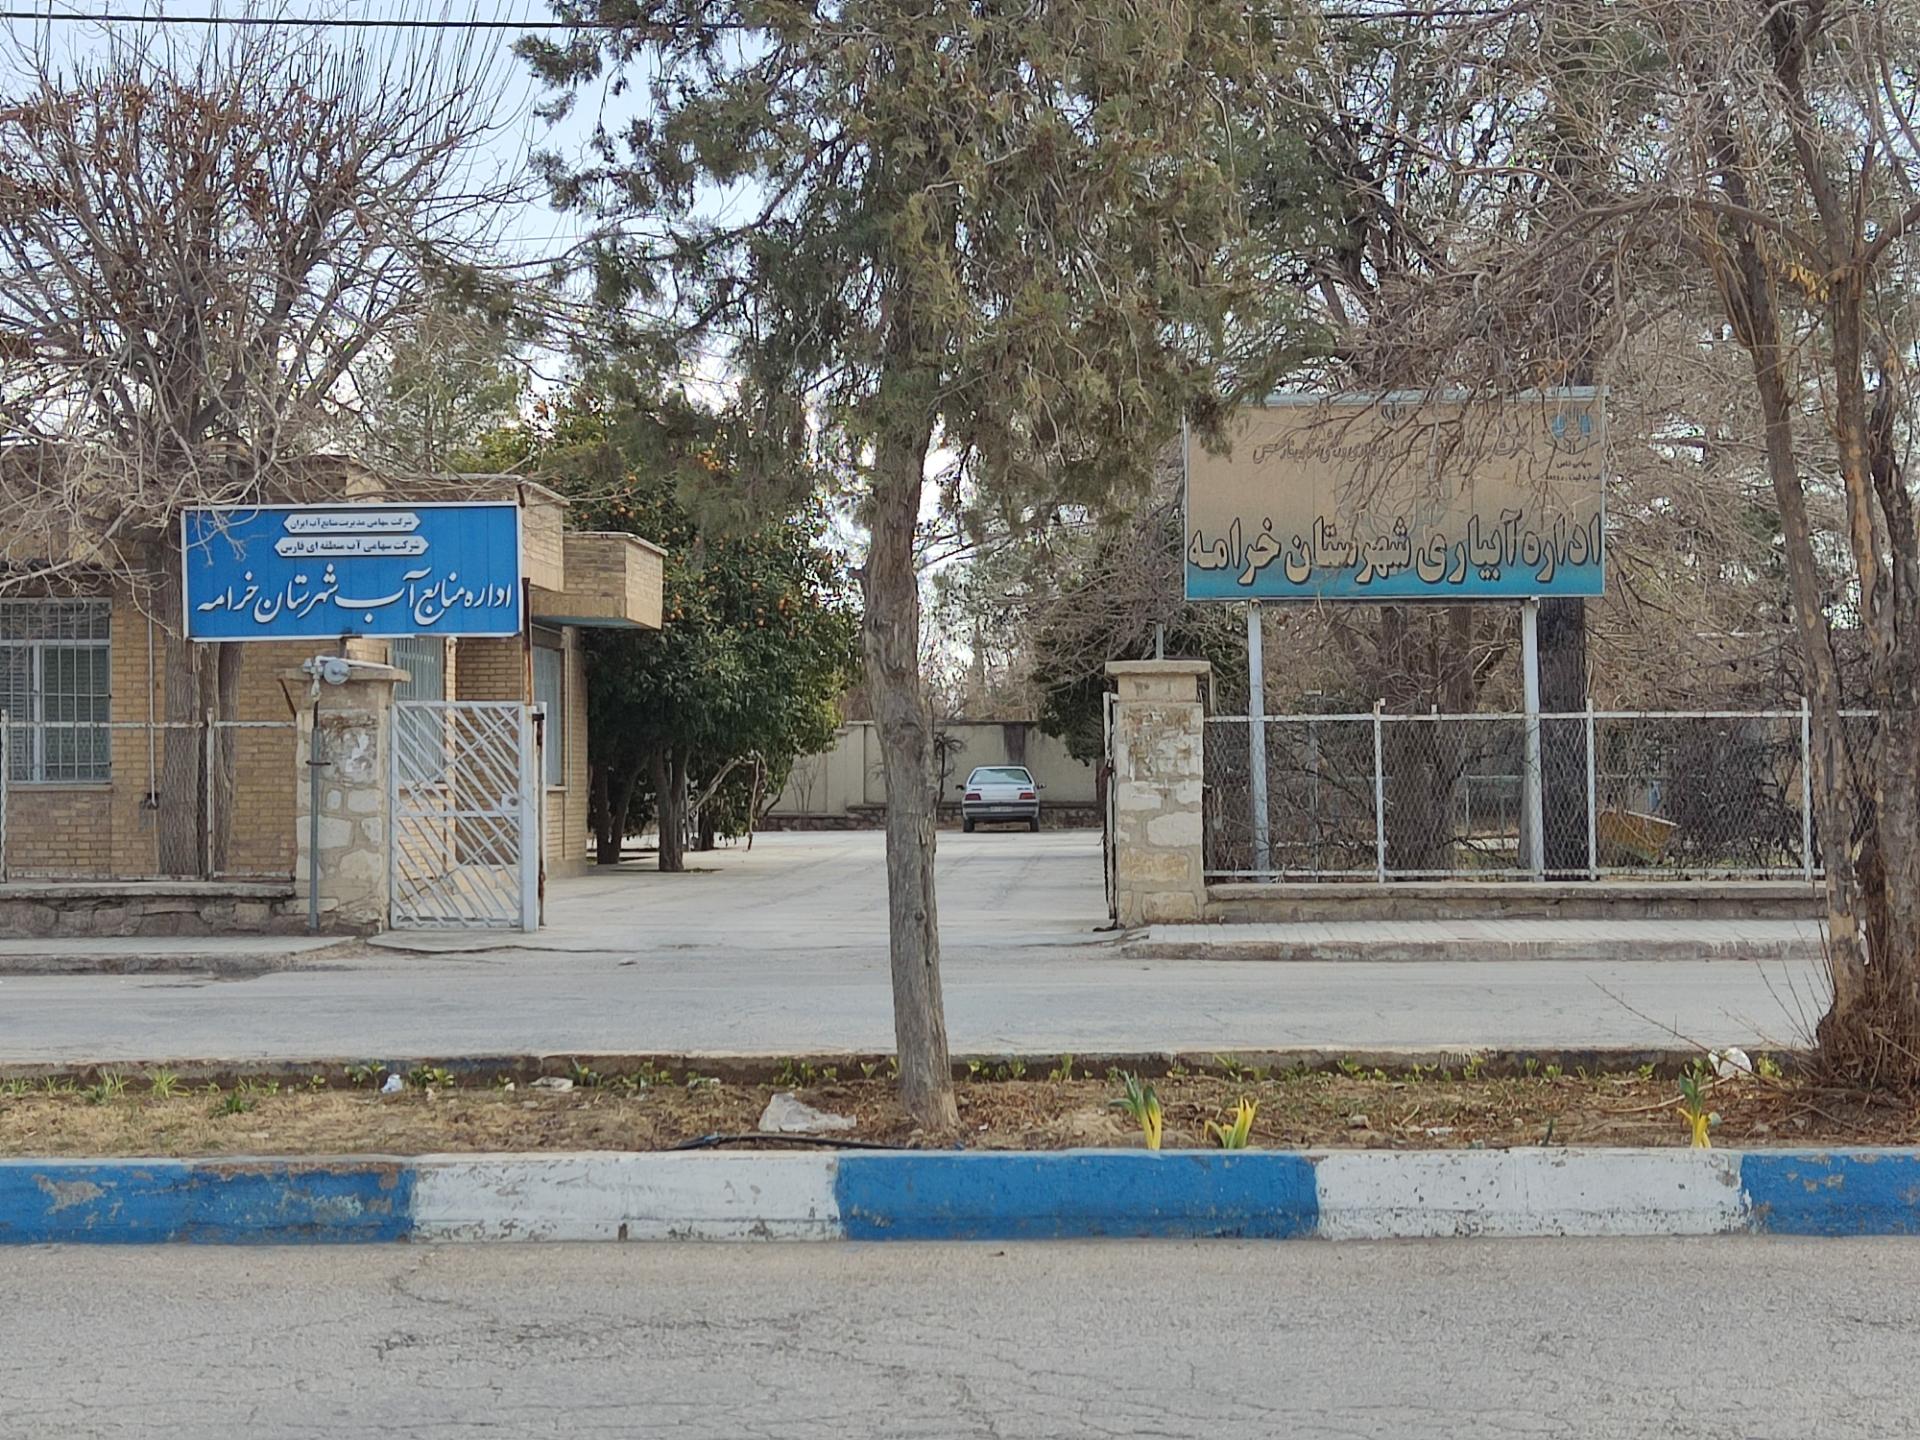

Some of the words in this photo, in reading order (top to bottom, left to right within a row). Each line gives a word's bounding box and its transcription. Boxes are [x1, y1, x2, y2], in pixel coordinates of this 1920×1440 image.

[280, 540, 305, 553] فارس
[306, 541, 318, 553] ای
[346, 539, 361, 550] آب
[363, 540, 392, 553] سهامی
[393, 540, 420, 552] شرکت
[1187, 516, 1282, 586] خرامه
[1283, 515, 1412, 585] شهرستان
[1416, 508, 1523, 583] آبیاری
[1522, 511, 1600, 583] اداره
[197, 571, 259, 612] خرامه
[253, 563, 339, 624] شهرستان
[335, 566, 432, 624] آب
[414, 571, 465, 626] منابع
[463, 583, 513, 609] اداره
